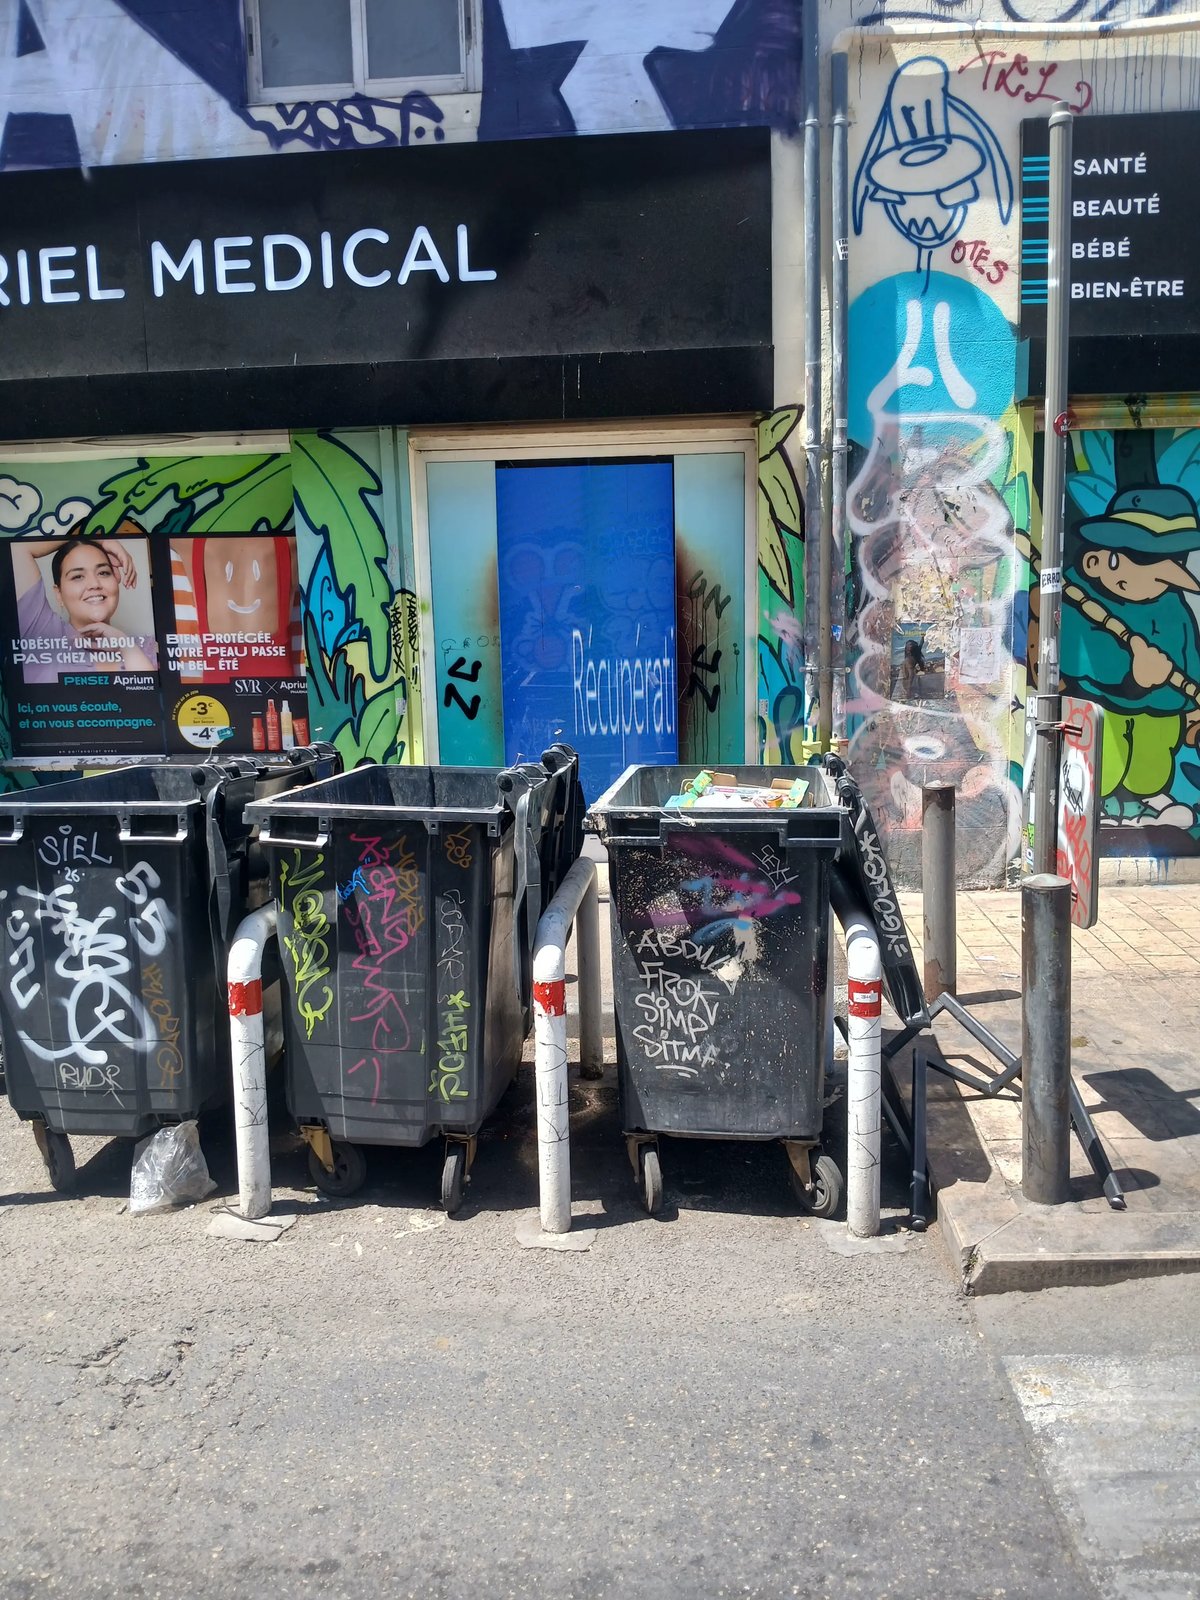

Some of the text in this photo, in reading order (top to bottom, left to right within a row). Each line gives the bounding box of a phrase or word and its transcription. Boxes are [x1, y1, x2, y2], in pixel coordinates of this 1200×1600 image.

[1073, 152, 1148, 176] SANTÉ
[1072, 193, 1160, 217] BEAUTÉ
[1071, 237, 1131, 259] BÉBÉ
[151, 224, 497, 298] MEDICAL
[1071, 276, 1185, 299] BIEN-ÊTRE
[12, 636, 145, 650] L'OBÉSITÉ, UN TABOU ?
[166, 631, 275, 645] BIEN PROTÉGÉE,
[13, 651, 125, 664] PAS CHEZ NOUS.
[167, 646, 286, 657] VOTRE PEAU PASSE
[168, 658, 239, 671] UN BEL ÉTÉ
[64, 675, 154, 686] PENSEZ Aprium
[235, 679, 262, 693] SVR
[18, 701, 122, 714] Ici, on vous écoute,
[19, 718, 156, 730] et on vous accompagne.
